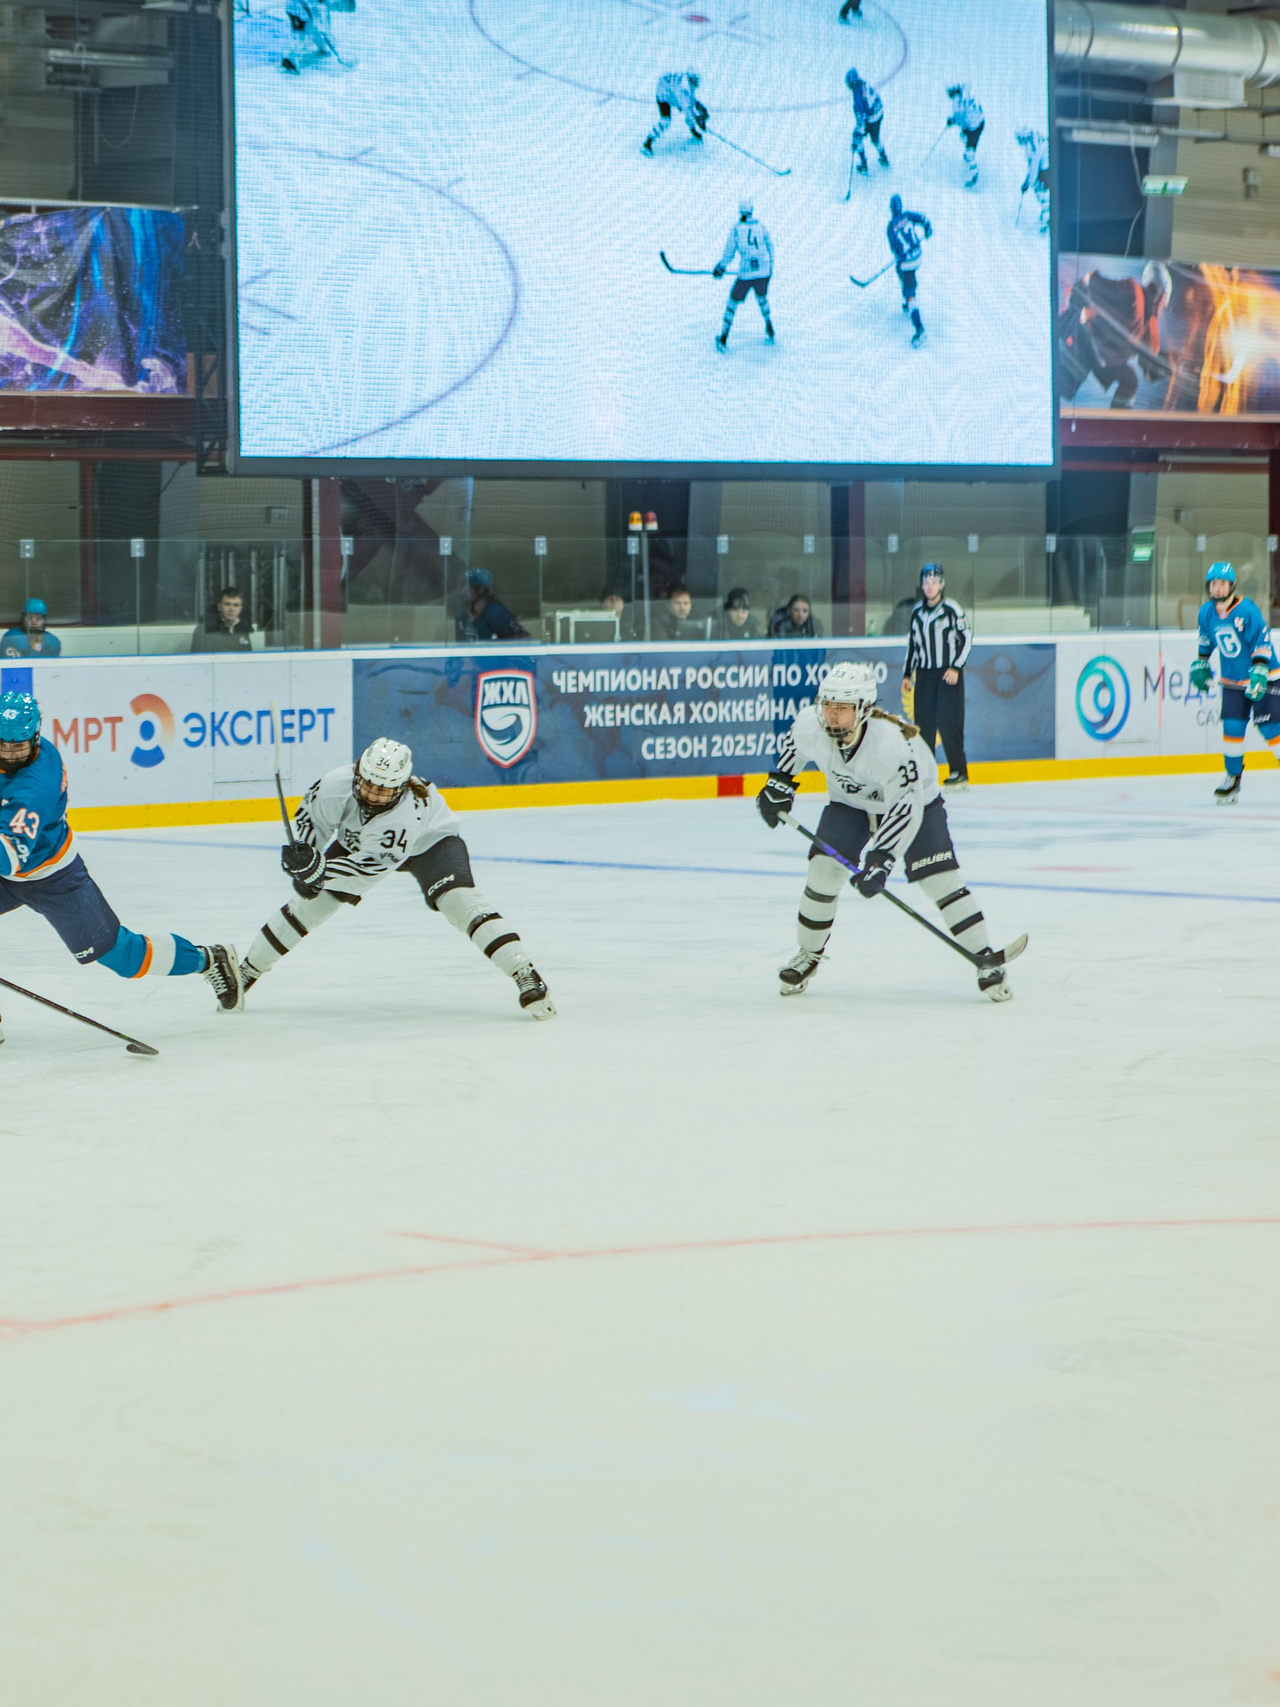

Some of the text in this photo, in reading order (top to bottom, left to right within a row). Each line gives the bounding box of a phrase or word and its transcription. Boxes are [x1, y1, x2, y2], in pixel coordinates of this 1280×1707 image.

[552, 667, 682, 694] ЧЕМПИОНАТ
[685, 664, 769, 690] РОССИИ
[773, 663, 802, 687] ПО
[483, 681, 529, 706] ЖХЛ
[2, 708, 18, 720] 43
[583, 701, 685, 729] ЖЕНСКАЯ
[52, 708, 336, 754] МРТ ЭКСПЕРТ
[640, 735, 708, 761] СЕЗОН
[376, 757, 390, 769] 34
[898, 760, 919, 787] 33
[9, 808, 40, 840] 43
[380, 828, 408, 853] 34
[911, 850, 953, 871] BAUER
[427, 874, 455, 897] CCM
